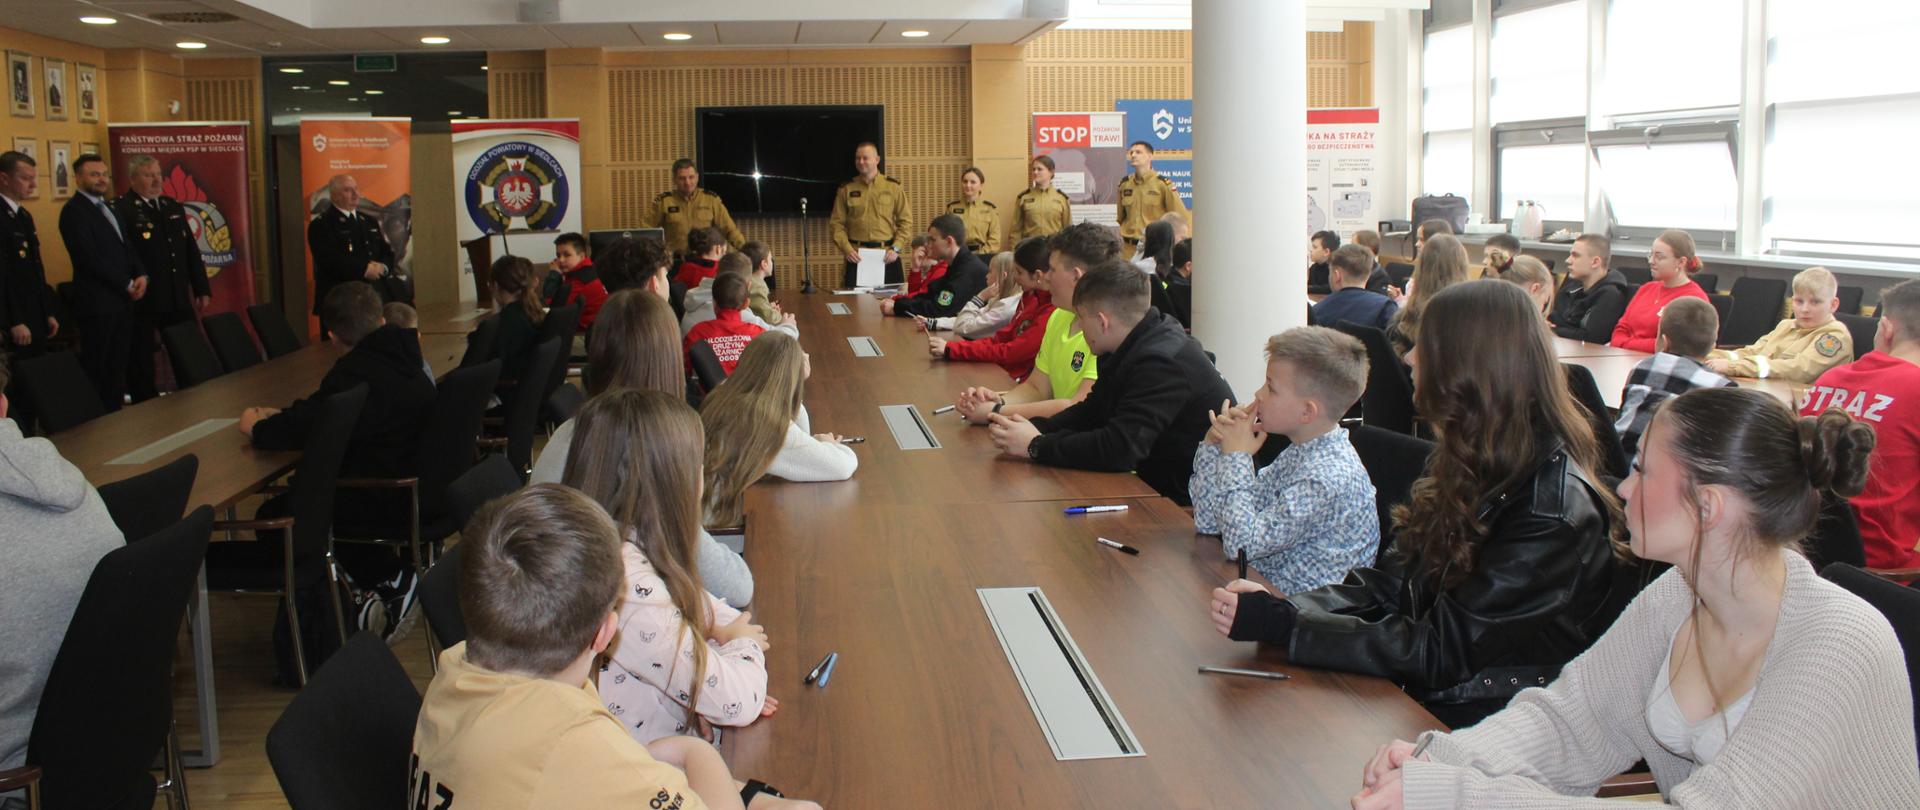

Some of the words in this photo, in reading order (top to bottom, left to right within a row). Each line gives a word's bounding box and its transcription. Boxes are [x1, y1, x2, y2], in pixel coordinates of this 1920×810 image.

[120, 133, 175, 143] PAŃSTWOWA
[177, 133, 203, 143] STRAŻ
[204, 132, 244, 143] POŻARNA
[1039, 126, 1088, 143] STOP
[1093, 135, 1121, 143] TRAW!
[1323, 132, 1336, 140] NA
[1339, 130, 1375, 140] STRAŻY
[121, 146, 157, 154] KOMENDA
[200, 145, 208, 153] W
[488, 143, 527, 158] POWIATOWY
[527, 144, 536, 153] W
[649, 787, 670, 810] OS
